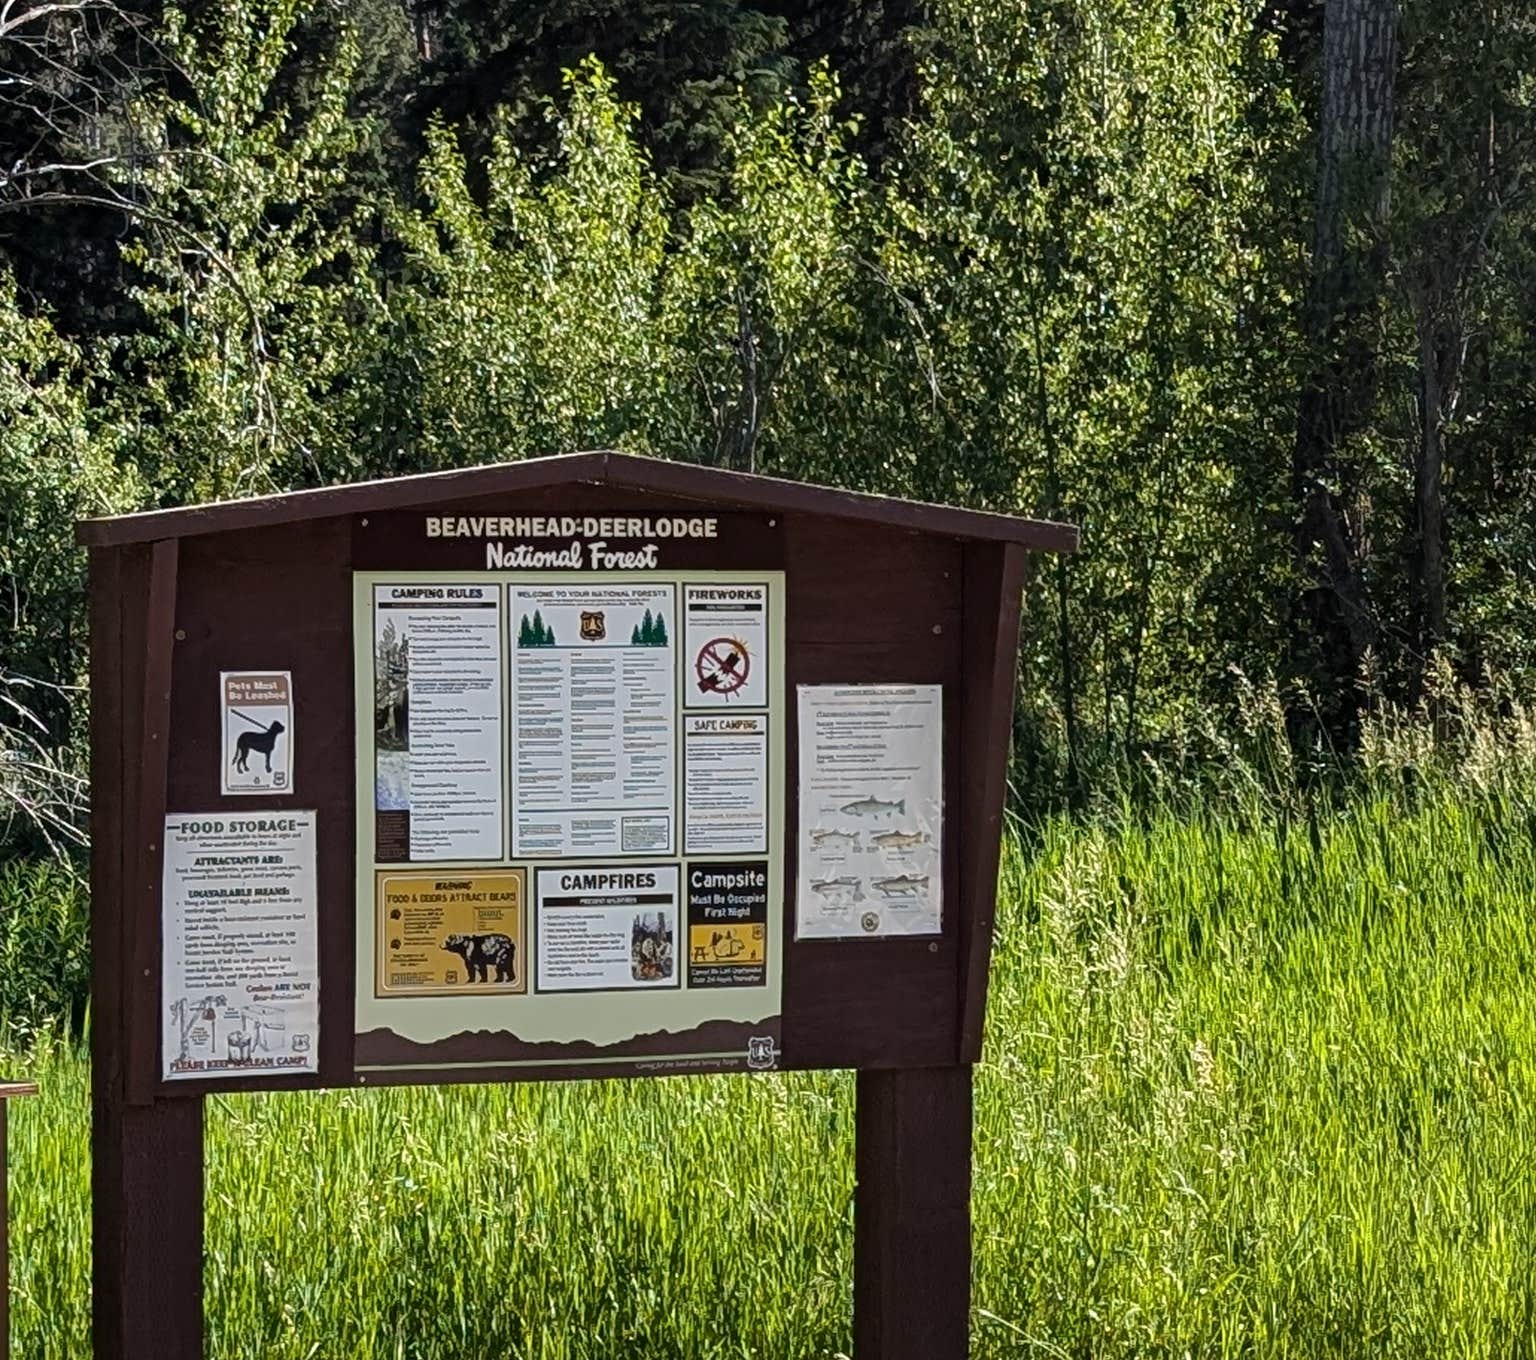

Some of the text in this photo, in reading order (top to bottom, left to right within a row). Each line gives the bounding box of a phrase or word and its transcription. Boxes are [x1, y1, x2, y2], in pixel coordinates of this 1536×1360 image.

[486, 541, 658, 570] National Forest
[392, 589, 483, 598] CAMPING RULES
[592, 590, 630, 598] NATIONAL
[688, 590, 762, 599] FIREWORKS
[228, 682, 277, 690] Pets Must
[229, 691, 286, 700] Be Leashed
[694, 720, 758, 730] SAFE CAMPING
[181, 820, 297, 834] FOOD STORAGE
[194, 855, 283, 866] ATTRACTANTS ARE:
[561, 873, 656, 890] CAMPFIRES
[691, 870, 765, 889] Campsite
[434, 881, 473, 890] WARNING
[188, 887, 289, 898] UNAVAILABLE MEANS:
[387, 894, 409, 903] FOOD
[412, 894, 418, 903] &
[449, 893, 488, 902] ATTRACT
[489, 893, 516, 902] BEARS
[690, 893, 765, 904] Must Be Occupied
[705, 907, 750, 918] First Night
[293, 983, 311, 991] NOT
